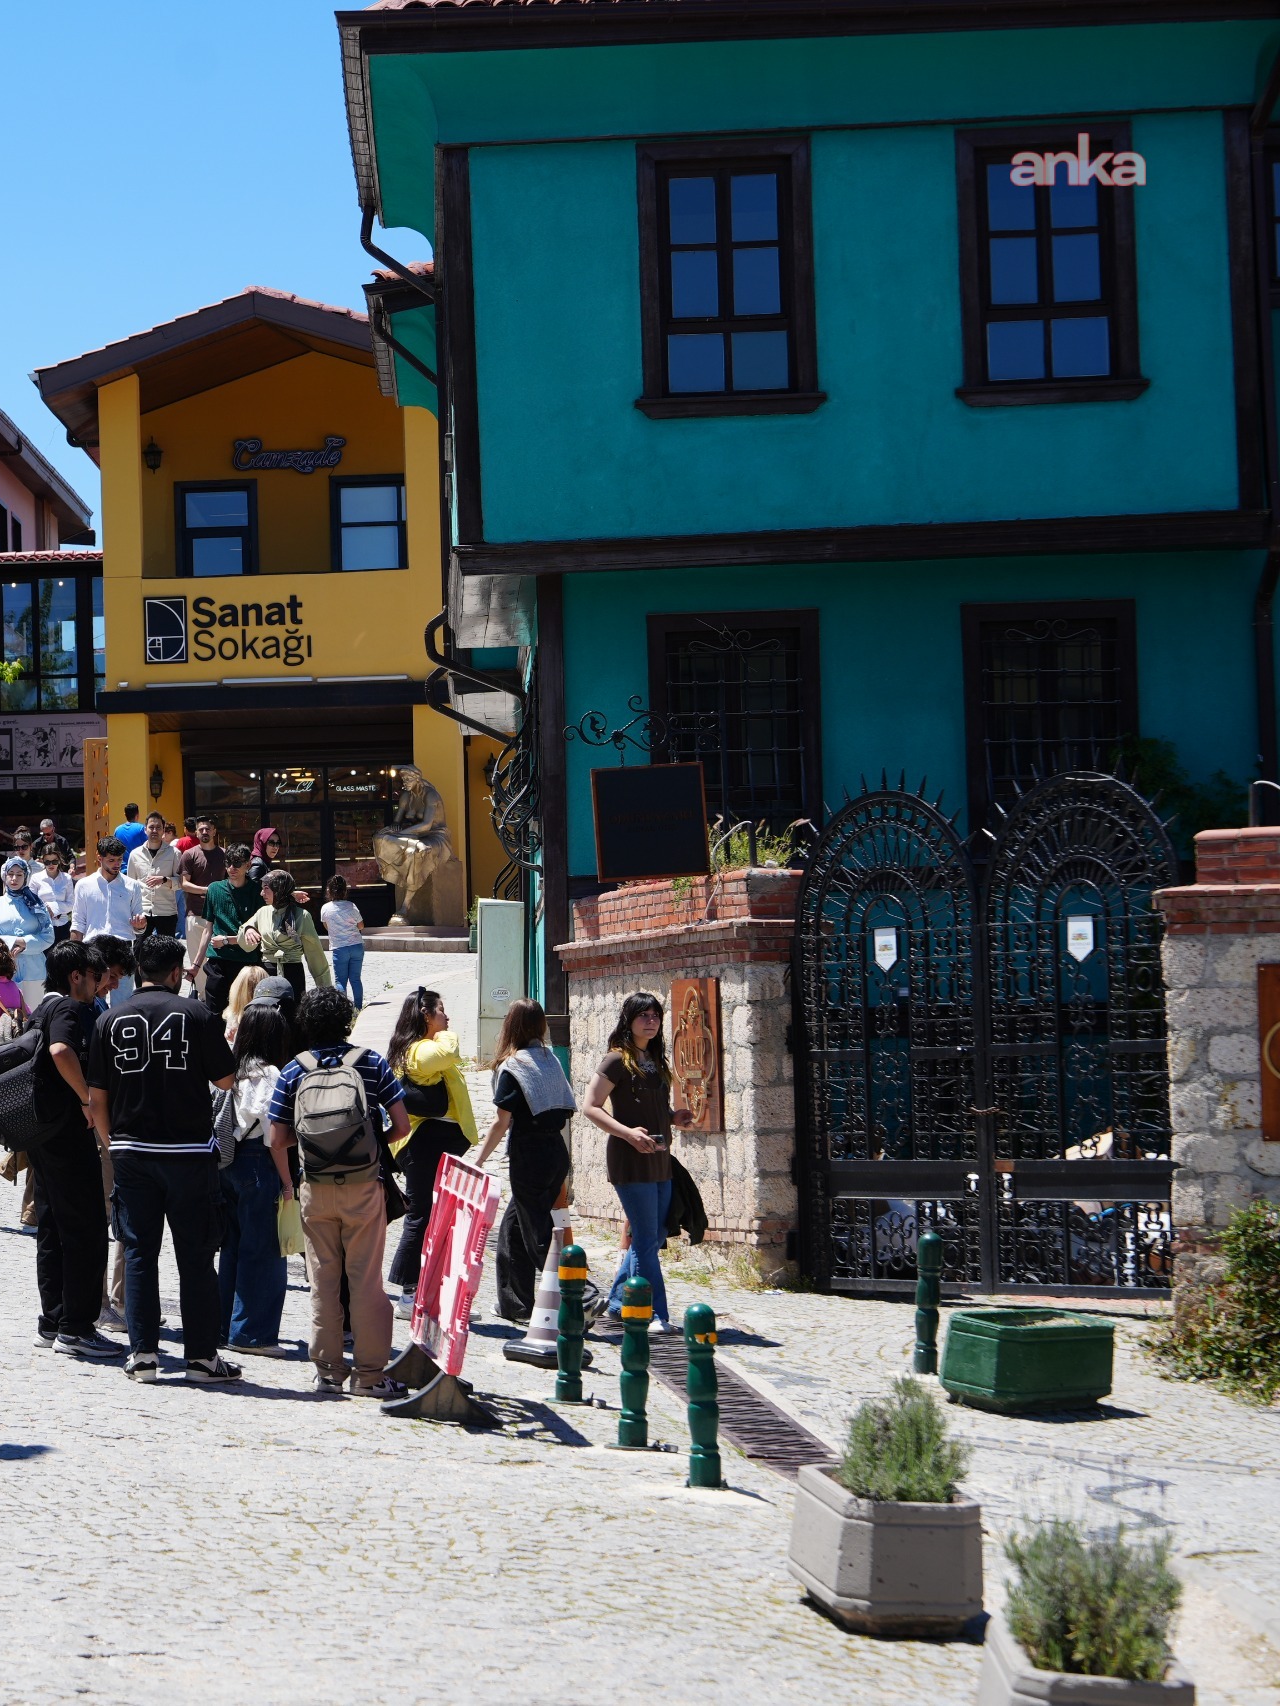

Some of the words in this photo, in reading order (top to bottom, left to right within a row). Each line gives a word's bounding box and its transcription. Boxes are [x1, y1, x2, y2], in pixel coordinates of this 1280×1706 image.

[192, 594, 303, 628] Sanat
[193, 628, 312, 667] Sokağı
[110, 1012, 189, 1074] 94
